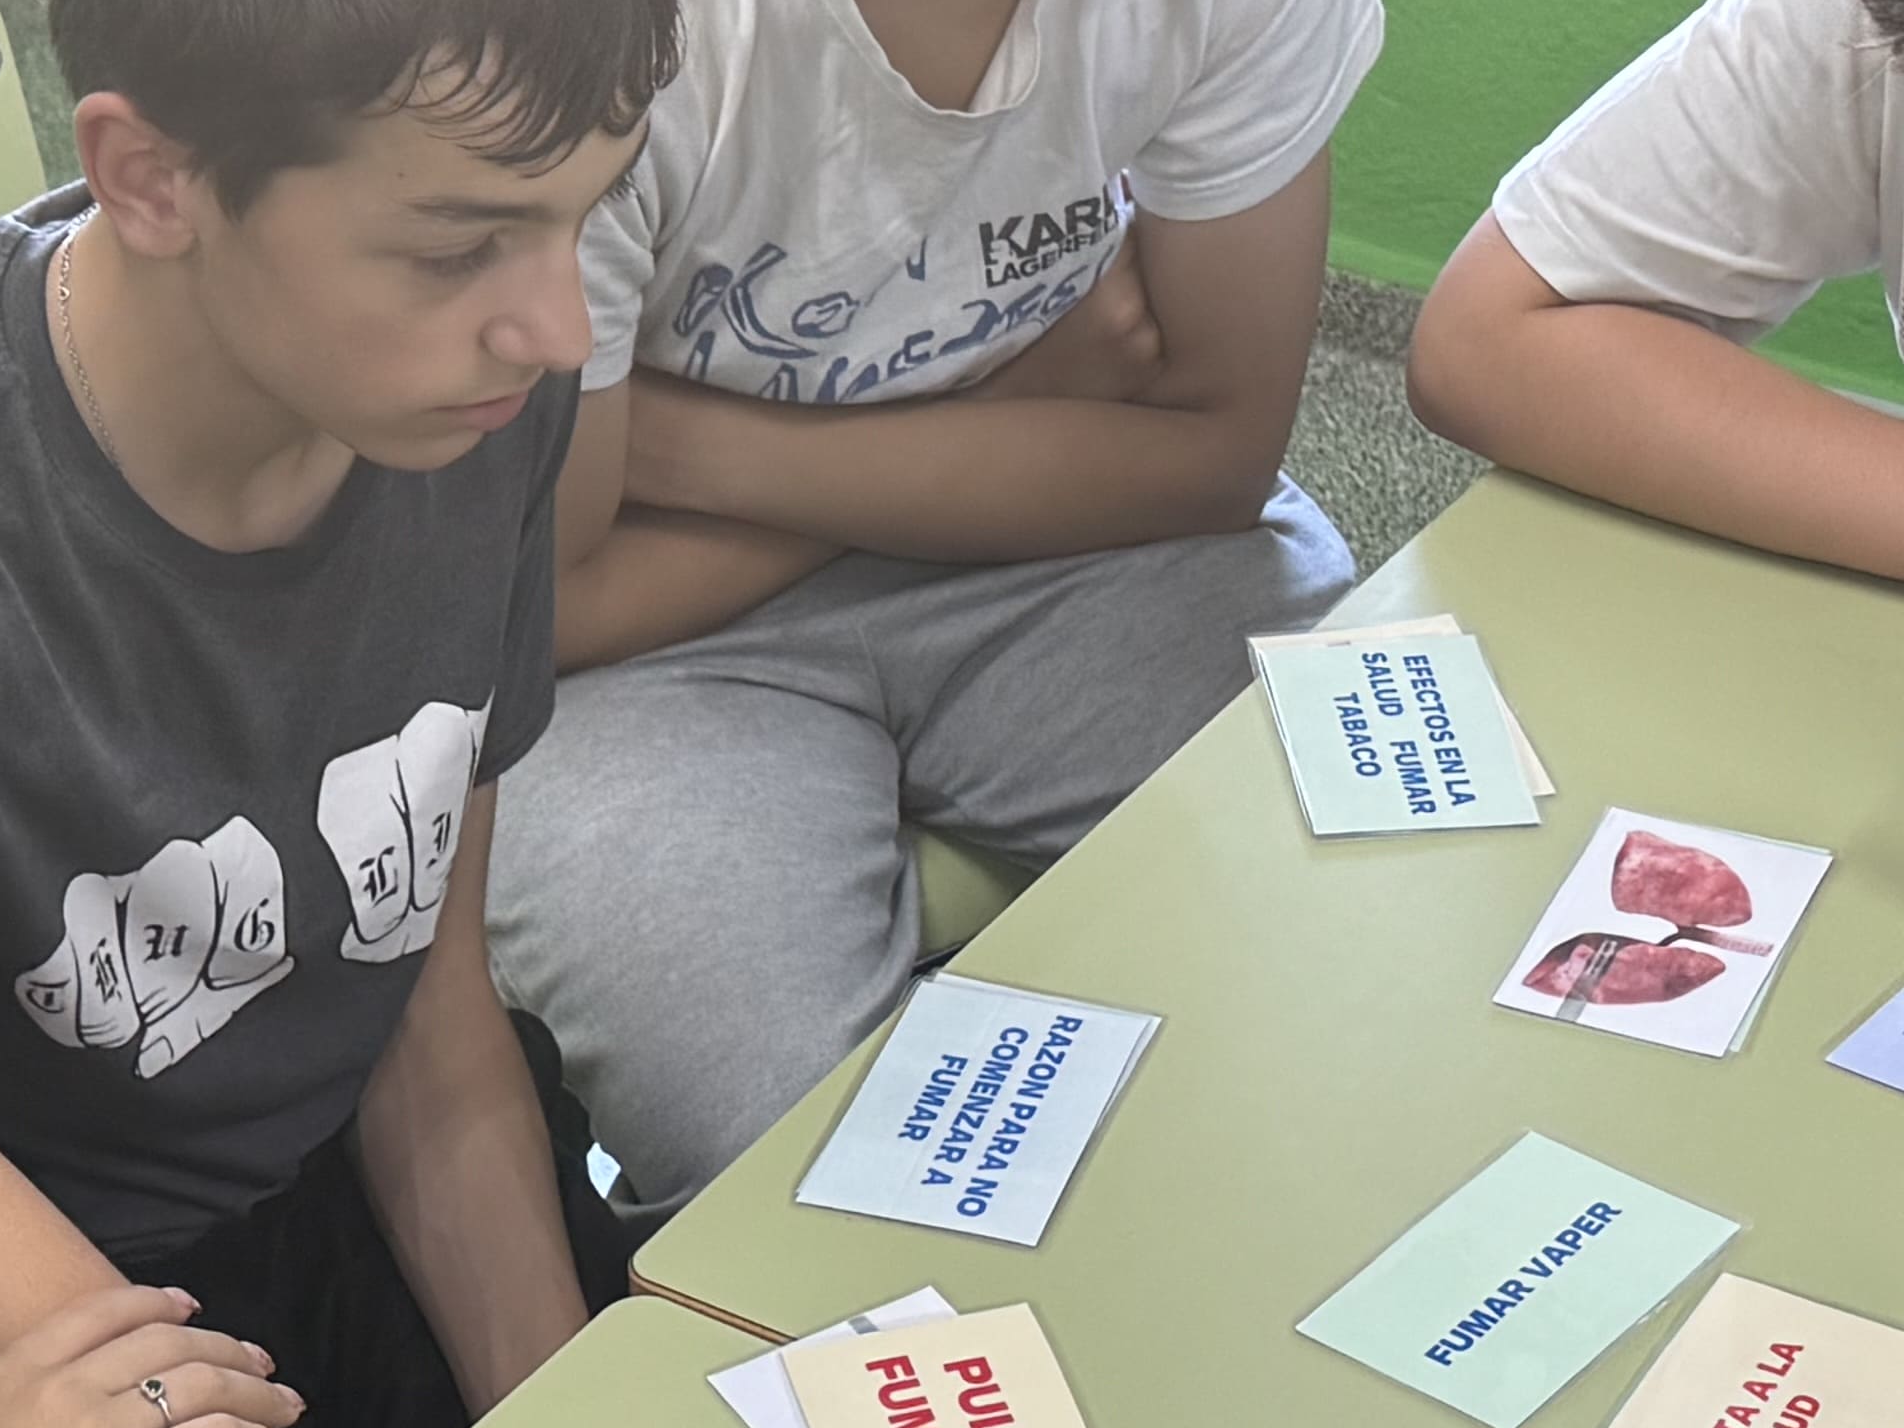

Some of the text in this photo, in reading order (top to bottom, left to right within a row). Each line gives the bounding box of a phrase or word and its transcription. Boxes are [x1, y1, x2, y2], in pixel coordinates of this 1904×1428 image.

[1333, 692, 1382, 777] TABACO
[1362, 652, 1437, 815] SALUD FUMAR
[1403, 654, 1476, 806] EFECTOS EN LA
[897, 1053, 968, 1142] FUMAR
[920, 1026, 1029, 1185] COMENZAR A
[956, 1015, 1084, 1218] RAZON PARA NO
[1423, 1201, 1623, 1367] FUMAR VAPER
[1756, 1342, 1804, 1377] LA
[1742, 1380, 1778, 1402] A
